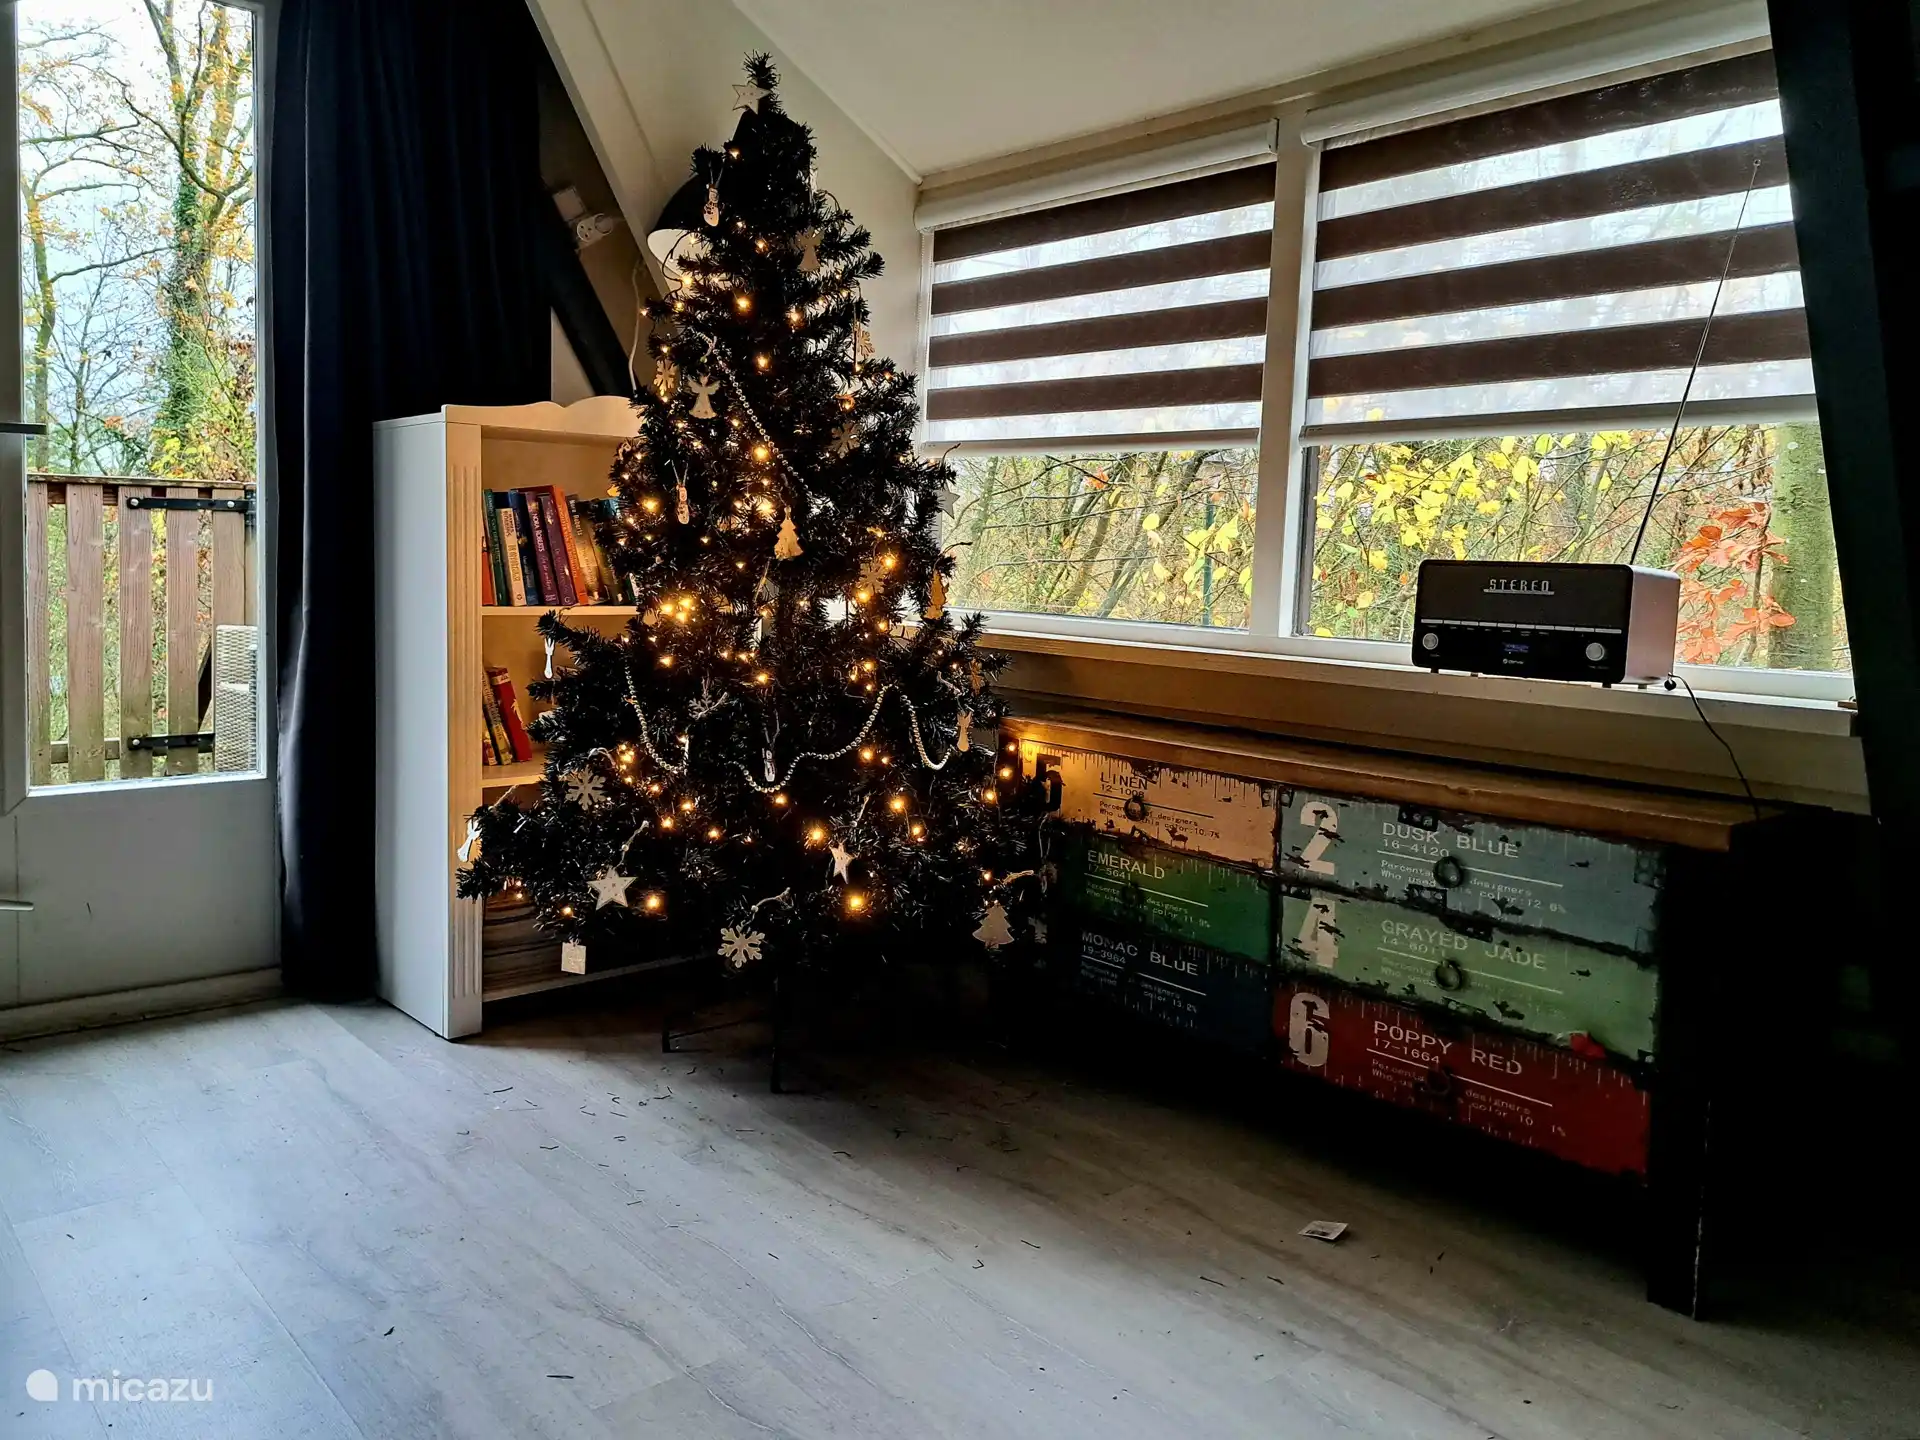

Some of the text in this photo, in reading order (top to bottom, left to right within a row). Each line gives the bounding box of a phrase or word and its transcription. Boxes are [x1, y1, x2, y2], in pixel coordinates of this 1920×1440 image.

[569, 499, 577, 513] Nora
[531, 512, 545, 552] NORA ROBERTS
[1489, 578, 1550, 592] STEREO
[1100, 771, 1148, 790] LINEN
[1300, 801, 1339, 876] 2
[1382, 822, 1519, 859] DUSK BLUE
[1383, 838, 1450, 858] 16-4120
[1087, 849, 1165, 880] EMERALD
[1081, 930, 1139, 957] MONAC
[1149, 950, 1200, 977] BLUE
[1381, 919, 1547, 971] GRAYED JADE
[1289, 992, 1330, 1067] 6
[1373, 1019, 1523, 1075] POPPY RED
[1375, 1037, 1441, 1065] 17-1664
